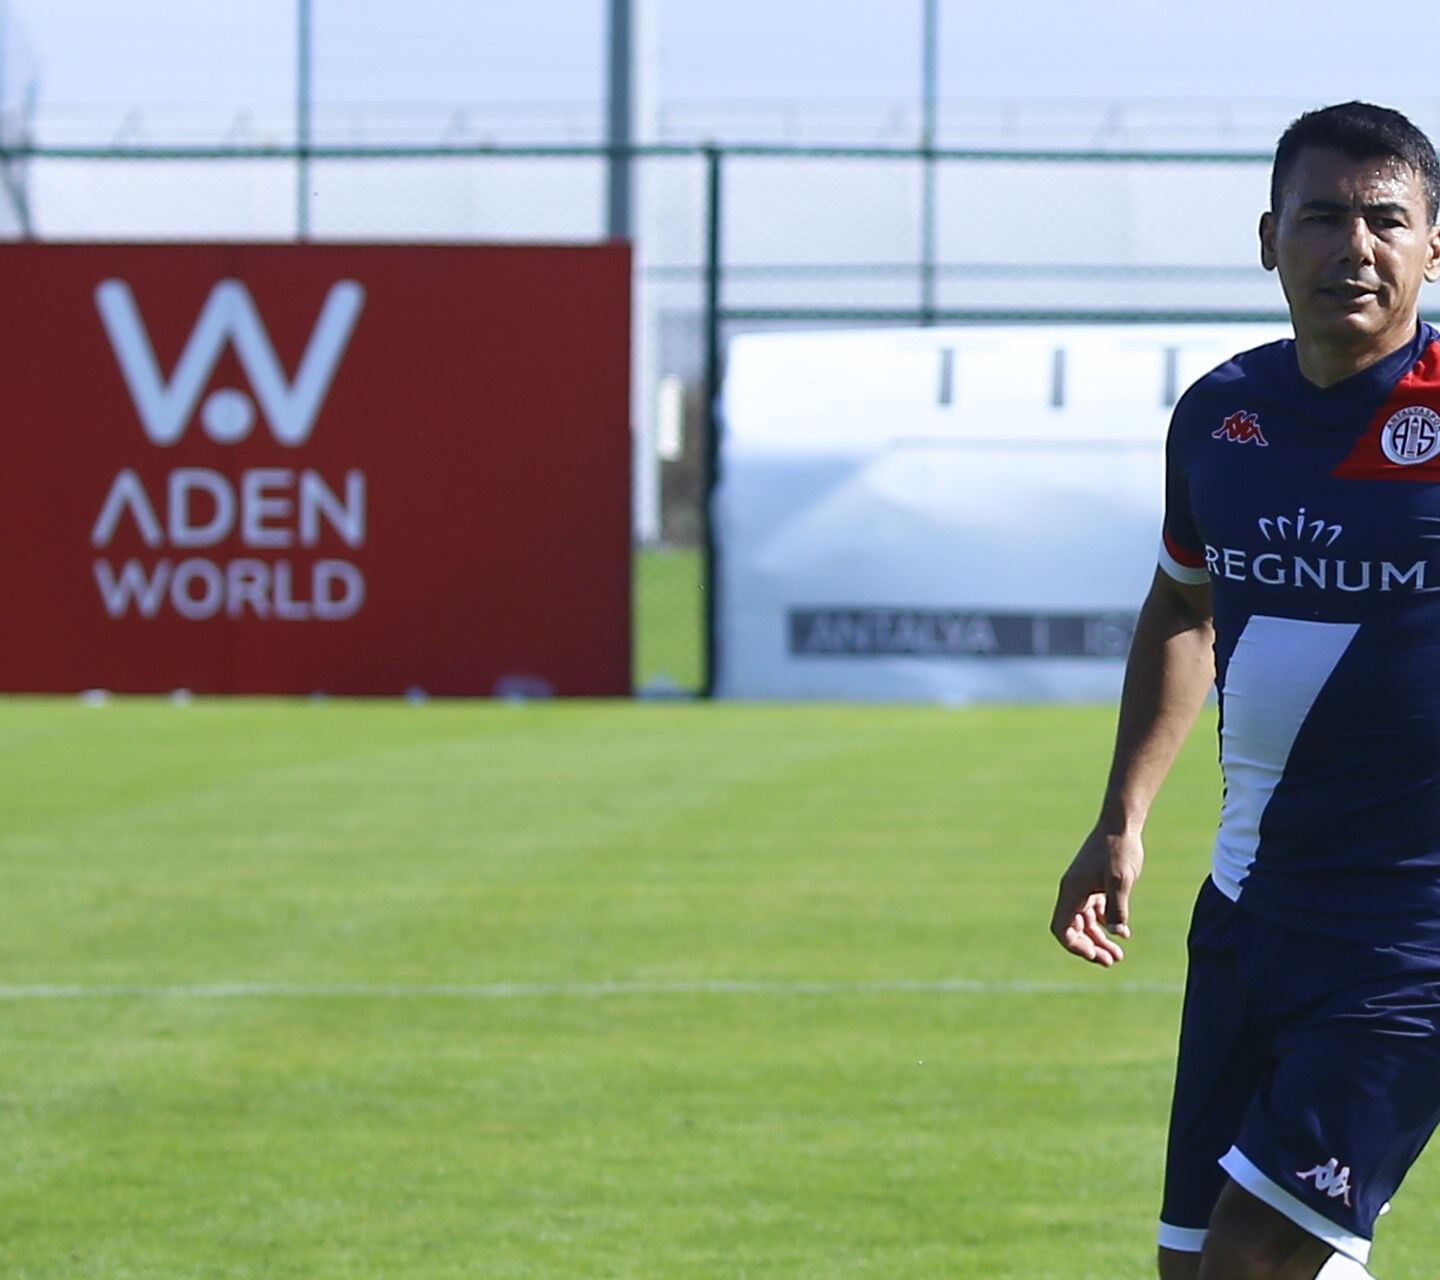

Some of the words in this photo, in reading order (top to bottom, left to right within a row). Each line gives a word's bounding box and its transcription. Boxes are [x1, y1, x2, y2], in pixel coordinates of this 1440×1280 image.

[92, 468, 367, 548] ADEN
[92, 558, 367, 621] WORLD
[1204, 543, 1428, 592] REGNUM
